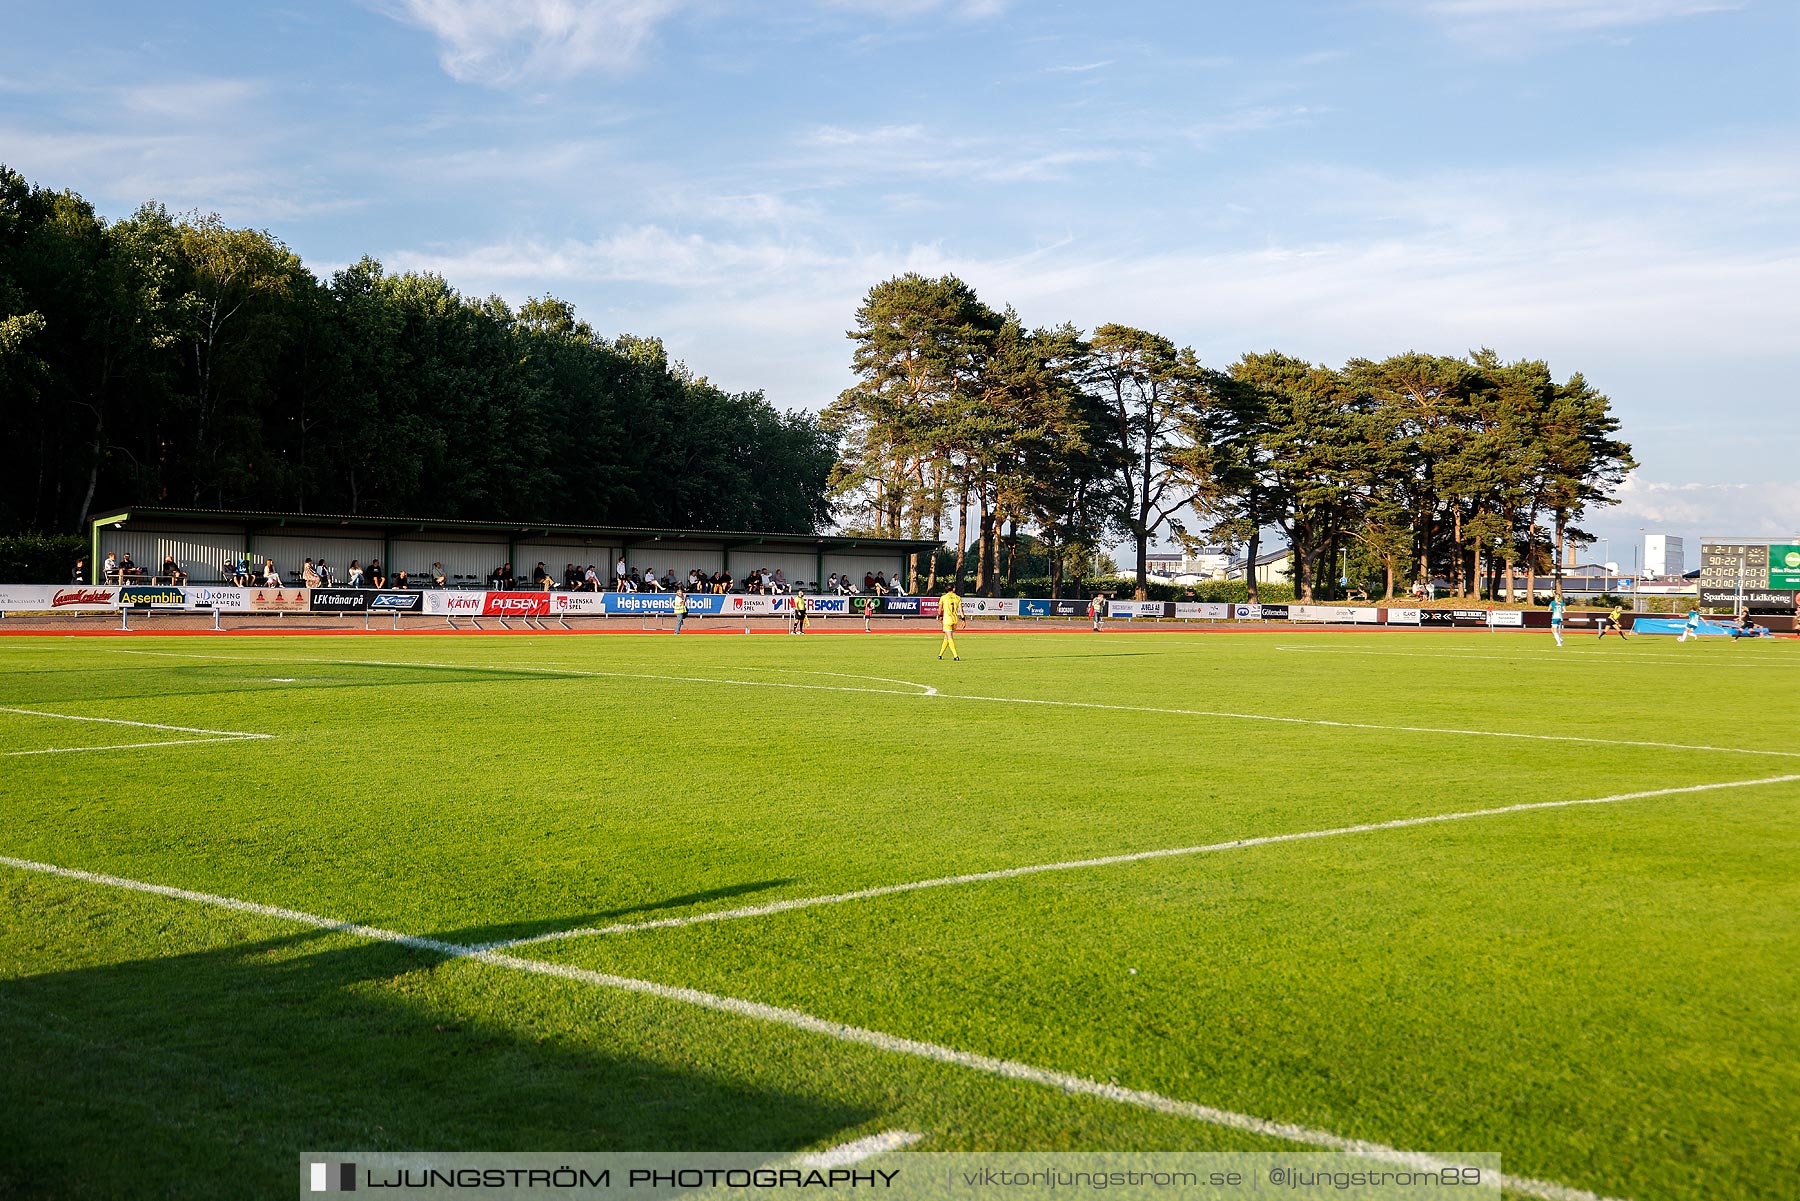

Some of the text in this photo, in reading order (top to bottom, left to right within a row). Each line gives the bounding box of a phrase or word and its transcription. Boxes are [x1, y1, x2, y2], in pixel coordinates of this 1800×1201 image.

[1709, 556, 1737, 566] 90:22
[121, 592, 183, 603] Assemblin
[313, 594, 329, 605] LFK
[328, 594, 353, 605] tränar
[352, 594, 364, 607] på
[447, 595, 480, 608] KÄNN
[1750, 593, 1790, 603] Lidköping
[491, 598, 539, 609] PULSEN
[617, 597, 712, 610] Heja svensk tboll!
[784, 598, 844, 611] INERSPORT
[887, 601, 917, 610] KINNEX
